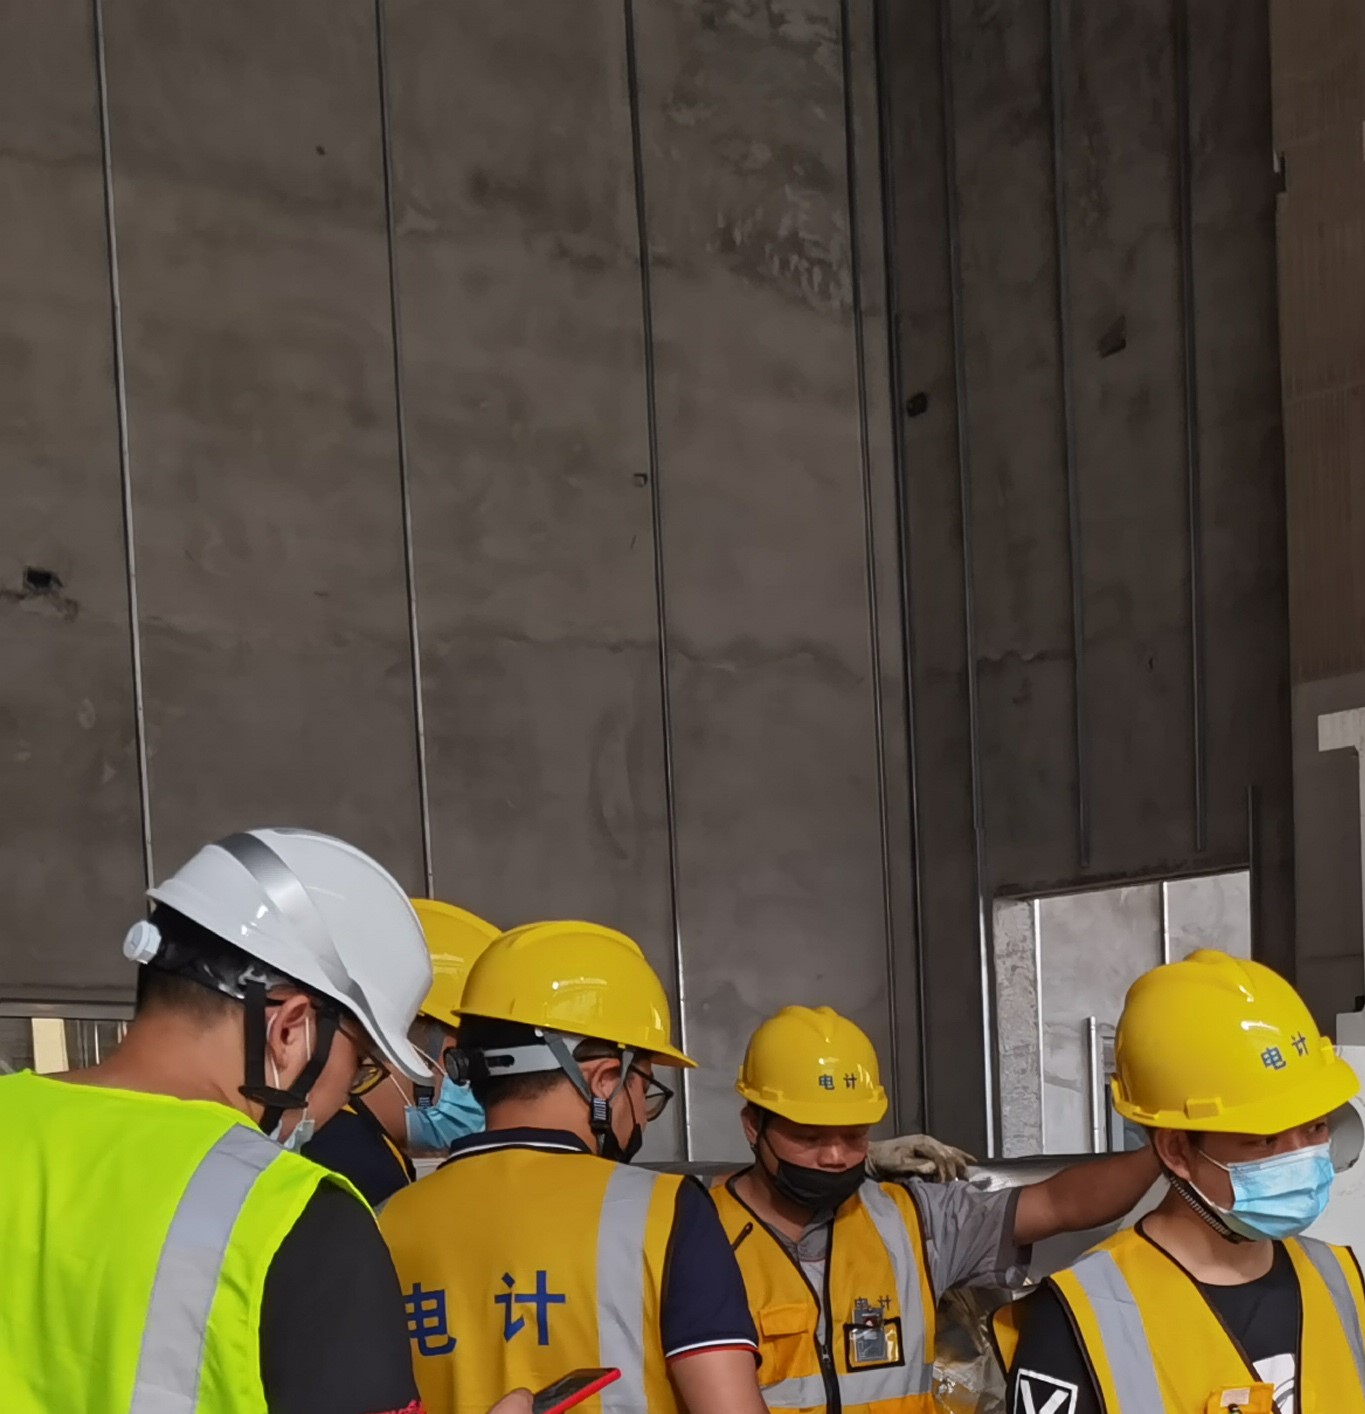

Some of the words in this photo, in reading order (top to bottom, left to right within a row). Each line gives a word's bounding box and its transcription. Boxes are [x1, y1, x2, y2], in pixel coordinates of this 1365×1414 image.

[1260, 1031, 1309, 1071] 电计
[818, 1073, 858, 1091] 电计
[401, 1270, 566, 1357] 电计
